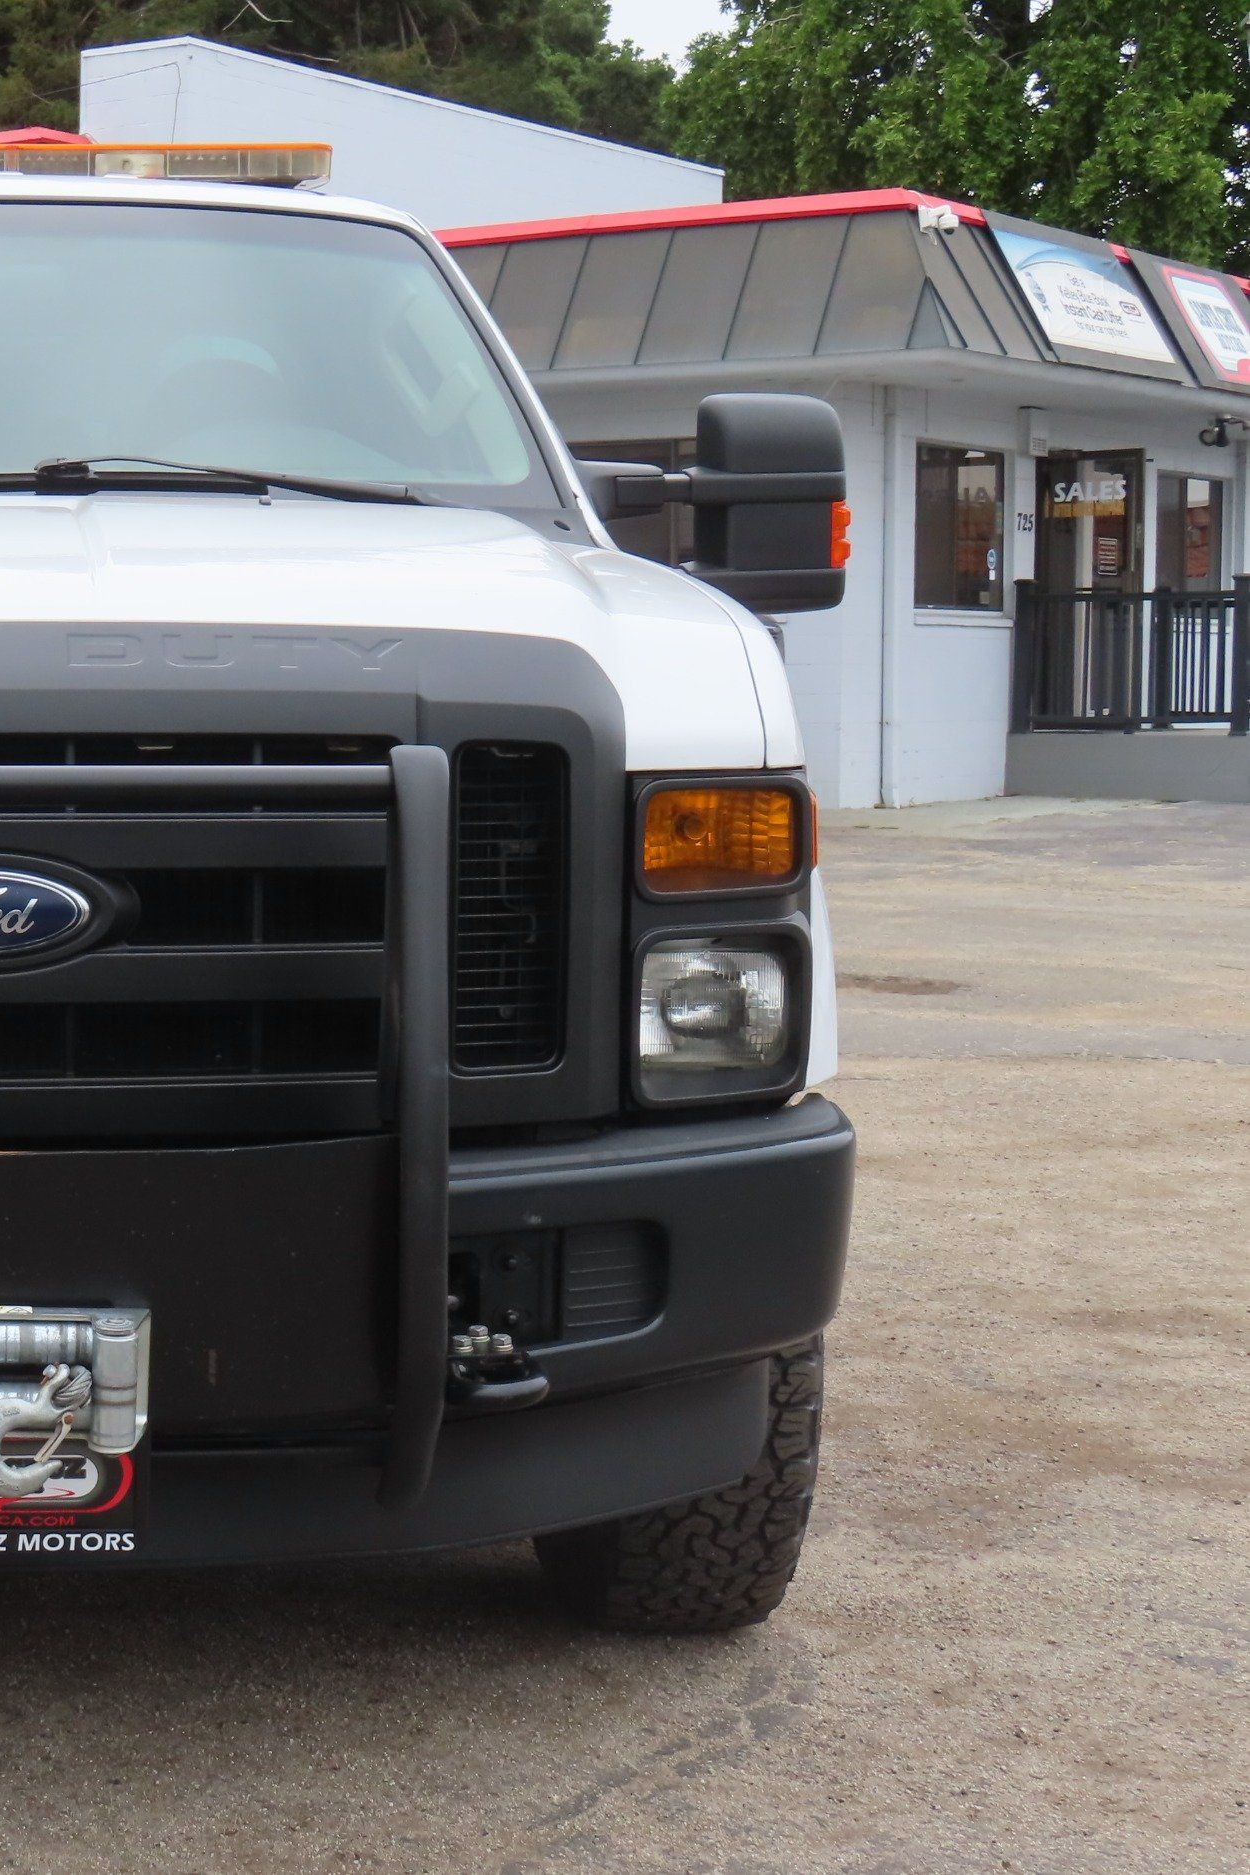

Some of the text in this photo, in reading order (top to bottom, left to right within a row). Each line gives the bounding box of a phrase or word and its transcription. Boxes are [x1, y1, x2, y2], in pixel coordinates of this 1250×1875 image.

[1054, 480, 1126, 502] SALES
[1017, 512, 1034, 532] 725
[67, 633, 403, 670] DUTY
[17, 1533, 135, 1551] MOTORS
